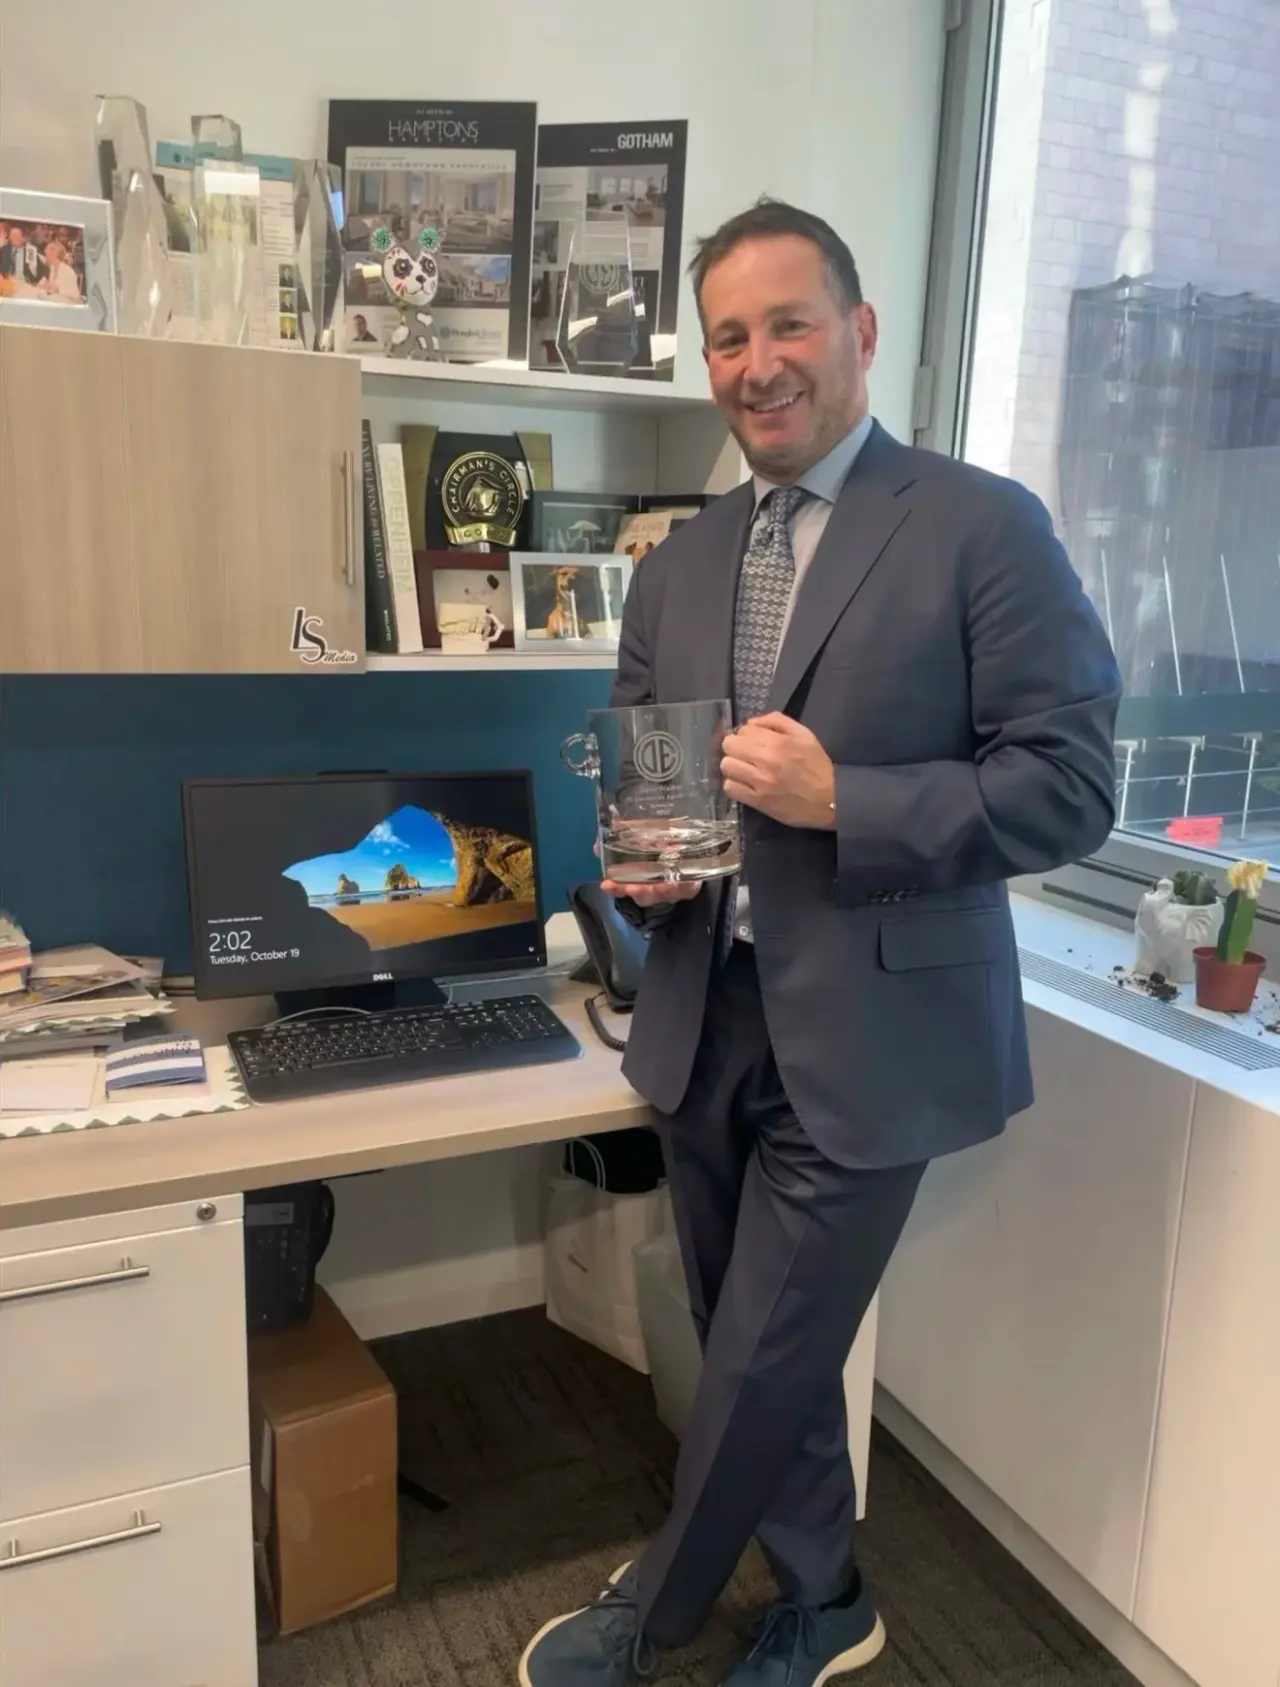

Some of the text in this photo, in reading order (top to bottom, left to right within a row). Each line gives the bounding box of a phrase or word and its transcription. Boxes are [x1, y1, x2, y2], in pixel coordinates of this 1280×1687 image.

[388, 120, 479, 138] HAMPTONS
[617, 132, 673, 149] GOTHAM
[449, 459, 517, 516] CHAIRMAN'S CIRCLE
[384, 456, 414, 592] OPPENHEIM
[371, 529, 385, 579] RELATED
[209, 931, 251, 952] 2:02
[209, 948, 300, 965] Tuesday, October 19
[373, 972, 394, 981] DELL
